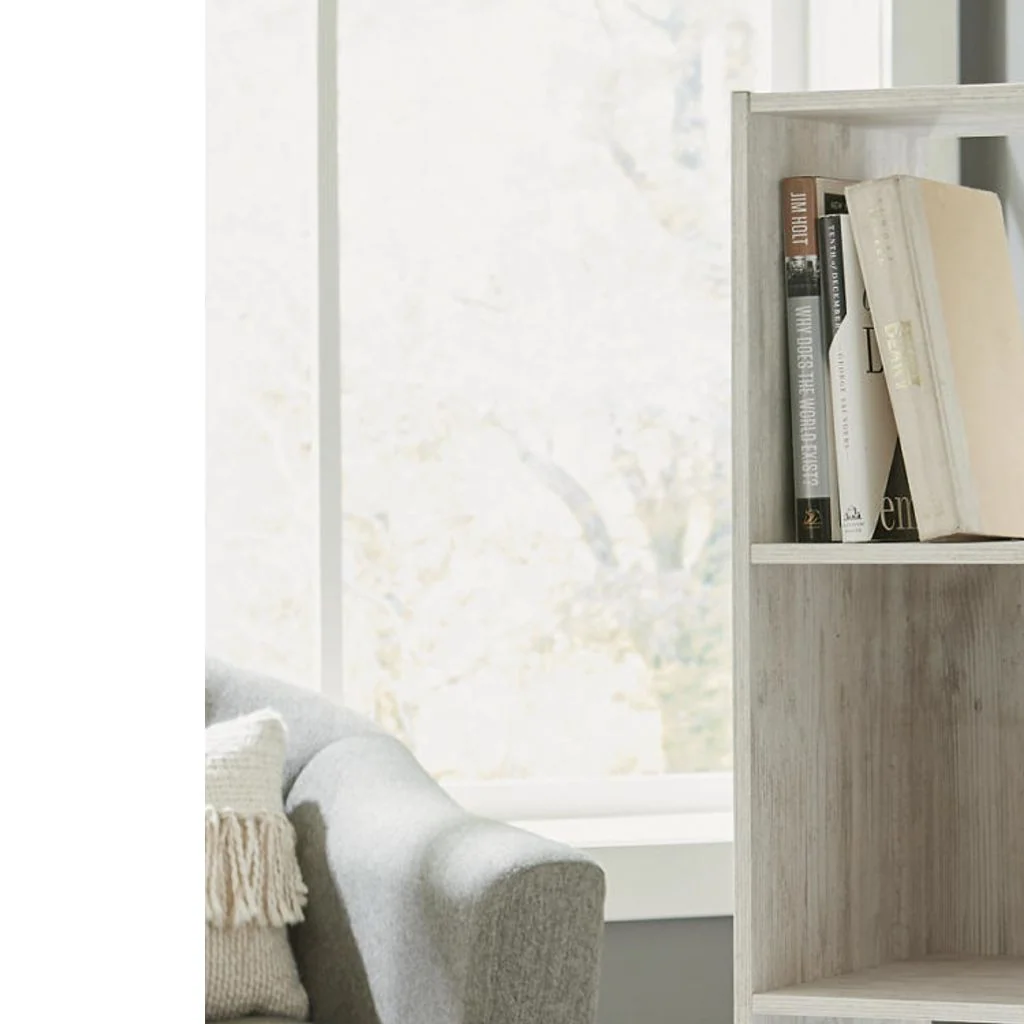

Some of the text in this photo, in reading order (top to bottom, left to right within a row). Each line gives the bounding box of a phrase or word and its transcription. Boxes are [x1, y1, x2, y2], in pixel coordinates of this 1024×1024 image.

[790, 192, 808, 246] JIM HOLT
[827, 225, 837, 258] TENTH
[795, 305, 819, 486] WHY DOES THE WORLD EXIST?
